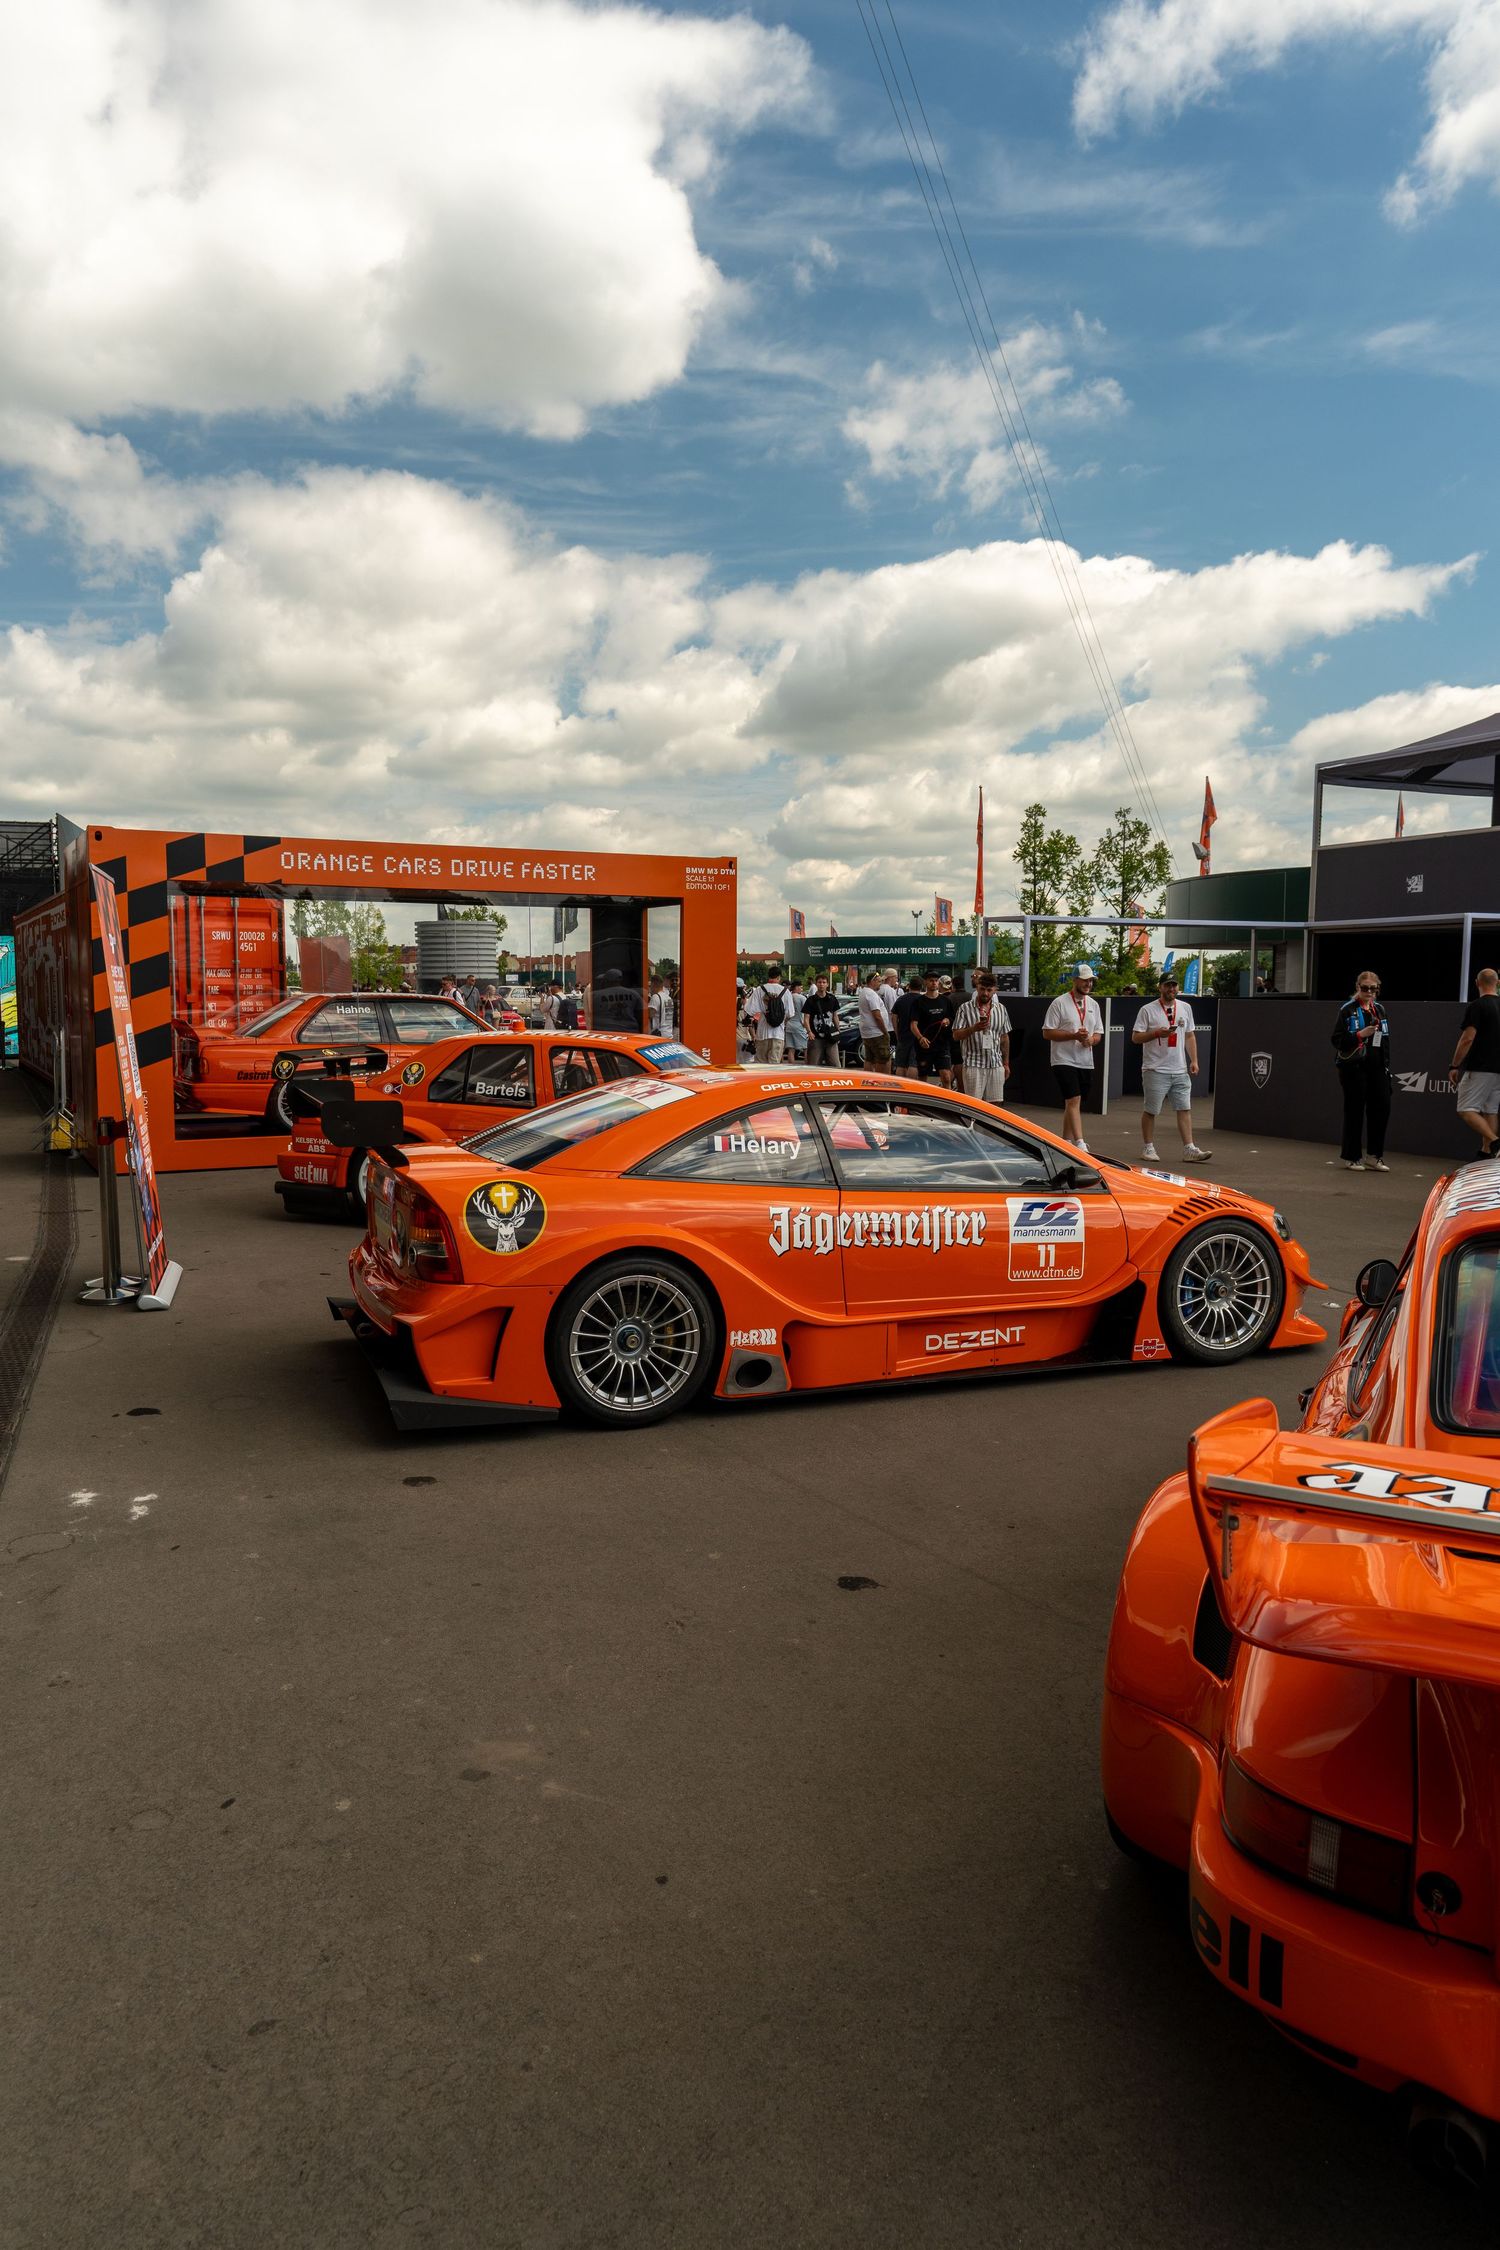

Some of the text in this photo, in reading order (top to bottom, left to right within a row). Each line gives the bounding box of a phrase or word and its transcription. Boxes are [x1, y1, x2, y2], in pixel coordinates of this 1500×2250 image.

[280, 851, 596, 882] ORANGE CARS DRIVE FASTER
[685, 866, 736, 876] BMW M3 DTM
[685, 874, 707, 882] SCALE
[685, 882, 713, 890] EDITION
[211, 930, 231, 941] SRWU
[239, 931, 265, 941] 200028
[239, 942, 257, 952] 45G1
[827, 947, 858, 955] MUZEUM
[860, 947, 908, 955] ZWIEDZANIE
[910, 947, 941, 955] TICKETS
[336, 1005, 371, 1014] Hahne
[237, 1070, 270, 1081] Castrol
[475, 1081, 526, 1098] Bartels
[760, 1082, 800, 1092] OPEL
[812, 1078, 854, 1088] TEAM
[1428, 1079, 1459, 1094] ULTR
[308, 1144, 326, 1154] ABS
[730, 1134, 801, 1160] Helary
[1013, 1201, 1081, 1227] D2
[1013, 1228, 1076, 1237] mannesmann
[1037, 1244, 1056, 1267] 11
[1012, 1266, 1080, 1278] www.dtm.de
[924, 1326, 1026, 1351] DEZENT
